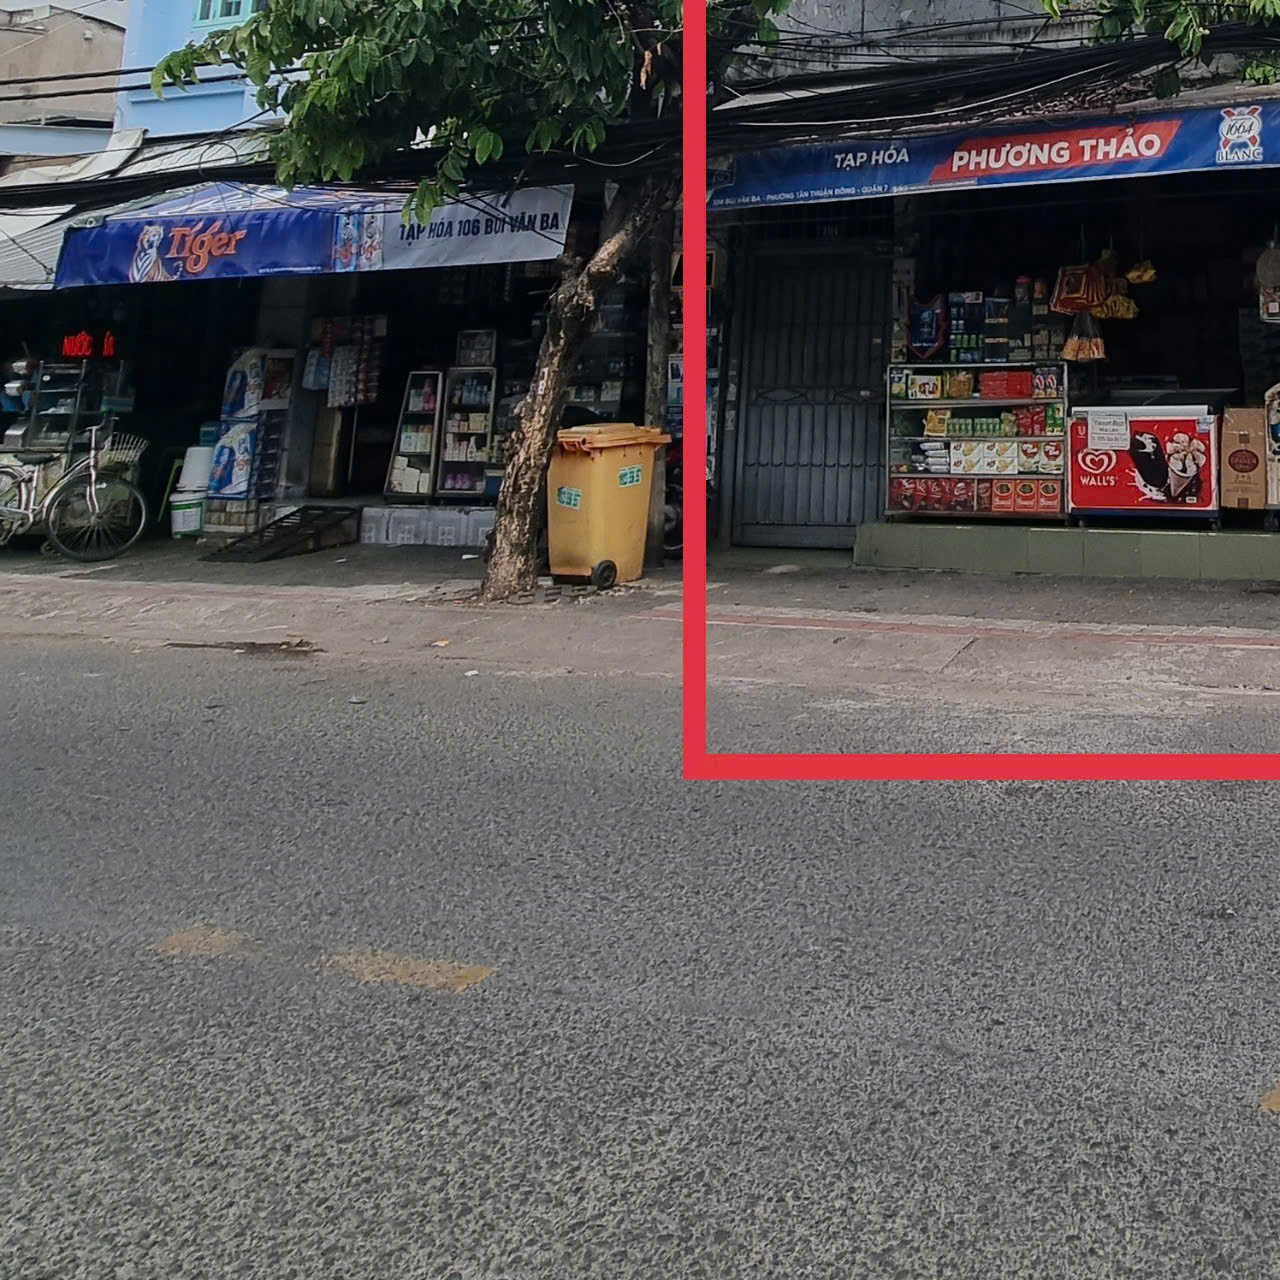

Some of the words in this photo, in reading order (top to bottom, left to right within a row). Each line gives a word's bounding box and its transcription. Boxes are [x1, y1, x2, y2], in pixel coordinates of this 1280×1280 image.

[834, 153, 866, 170] TẠP
[871, 145, 909, 164] HÓA
[952, 142, 1070, 172] PHƯƠNG
[1079, 127, 1161, 162] THẢO
[1217, 147, 1263, 162] BLANC
[457, 218, 480, 235] 106
[540, 211, 559, 230] BA
[166, 220, 247, 273] Tiger
[1080, 476, 1115, 486] WALL'S
